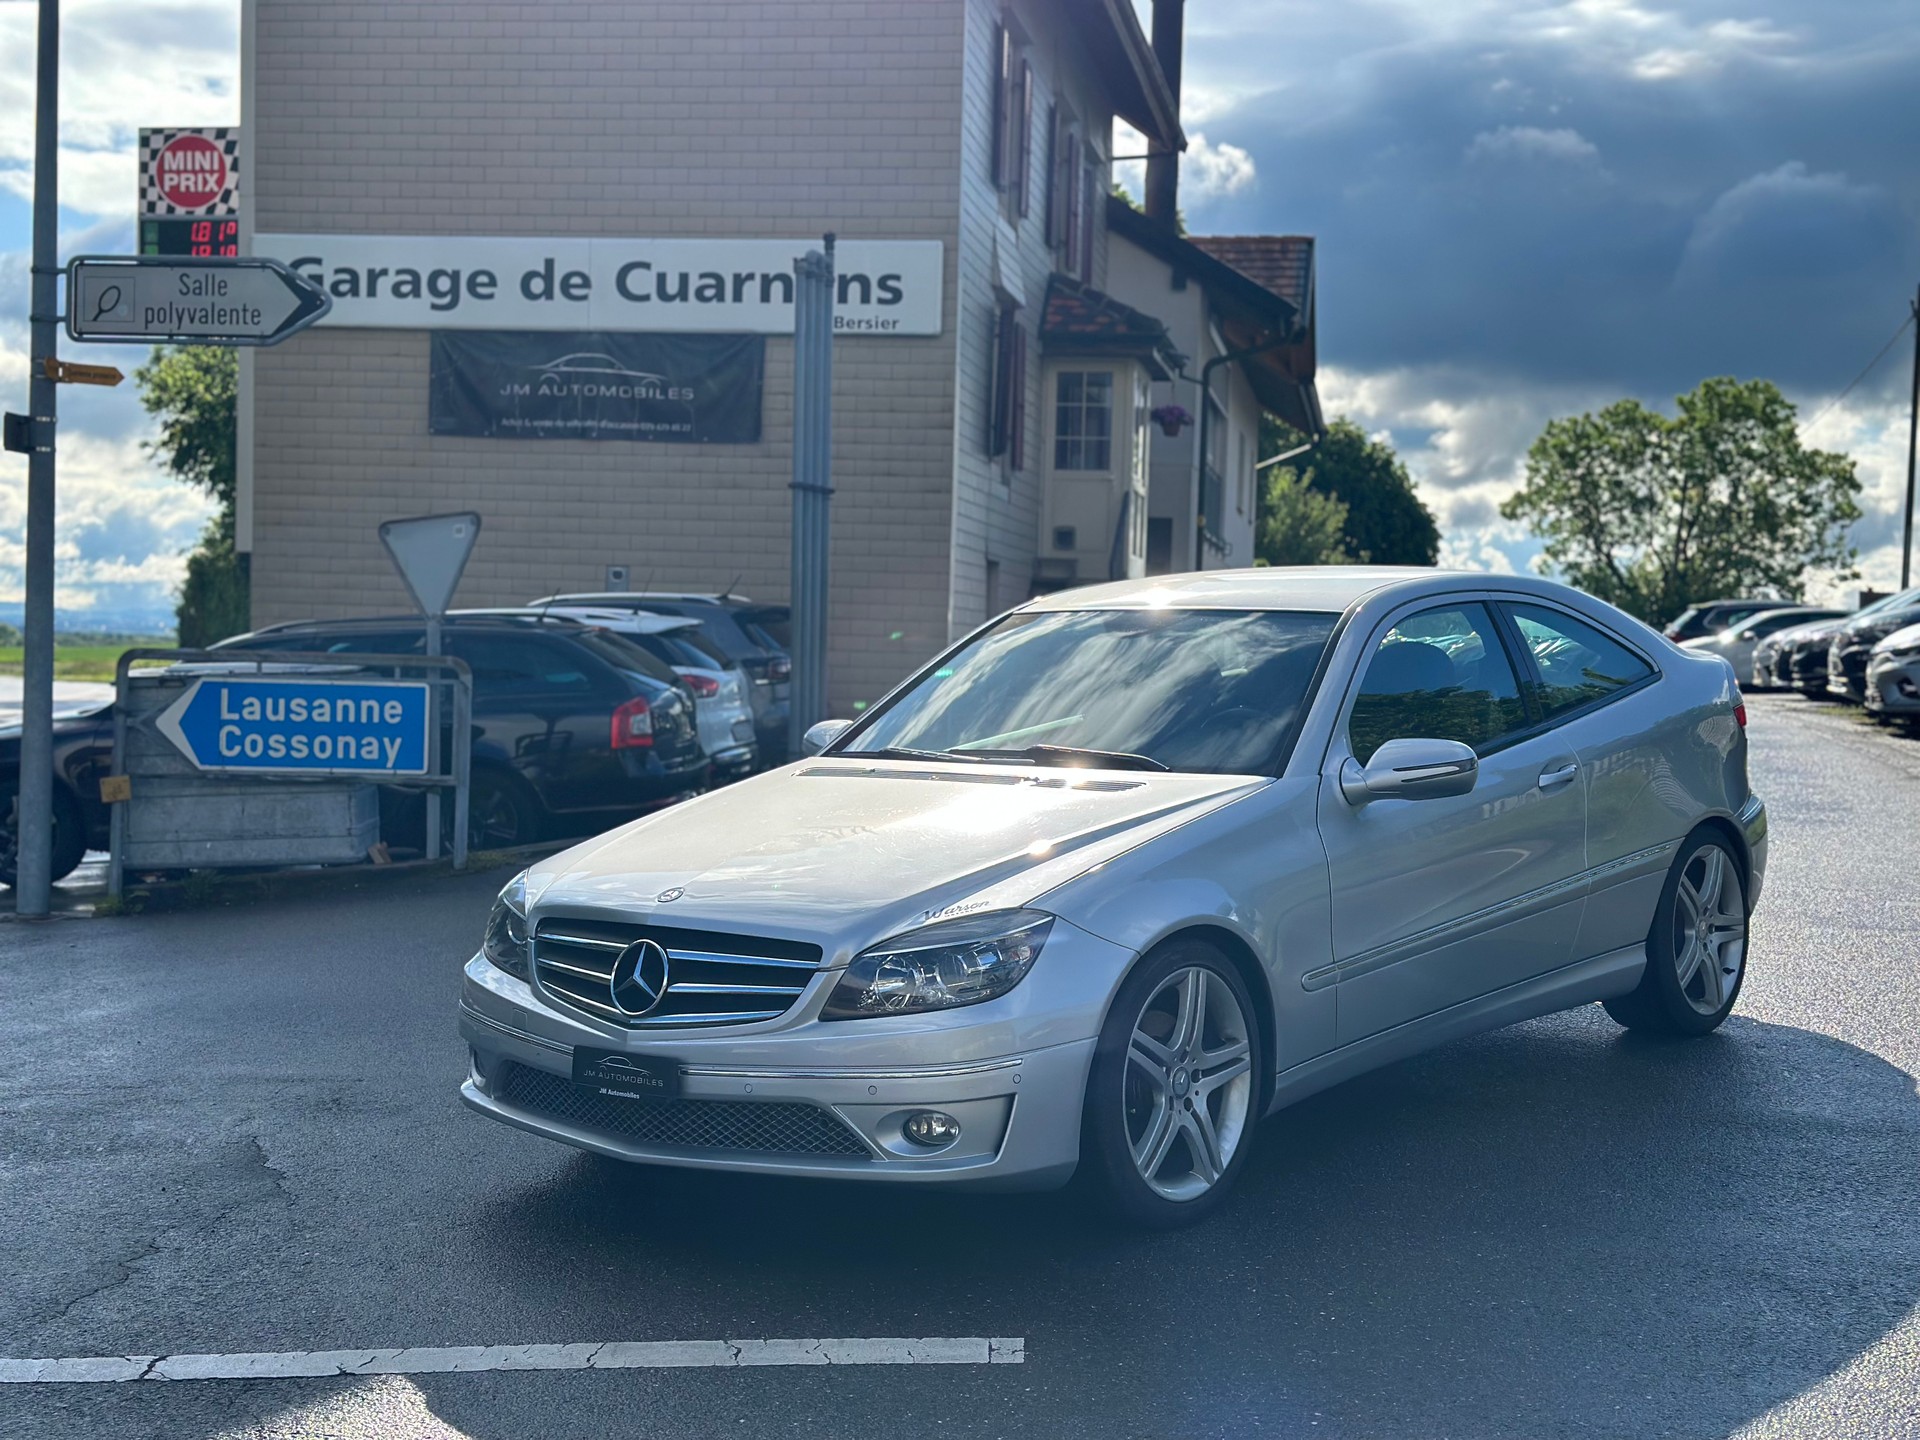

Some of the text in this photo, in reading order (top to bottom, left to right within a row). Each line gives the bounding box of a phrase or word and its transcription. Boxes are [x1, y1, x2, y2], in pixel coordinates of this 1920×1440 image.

[163, 150, 220, 171] MINI
[163, 173, 220, 193] PRIX
[179, 272, 228, 297] Salle
[519, 257, 592, 301] de
[615, 260, 904, 305] Cuarnns
[144, 300, 262, 332] polyvalente
[833, 315, 899, 331] Bersier
[500, 383, 694, 400] JM AUTOMOBILES
[220, 688, 403, 724] Lausanne
[219, 725, 402, 769] Cossonay
[583, 1069, 664, 1087] JM AUTOMOBILES
[607, 1088, 640, 1099] Automobiles
